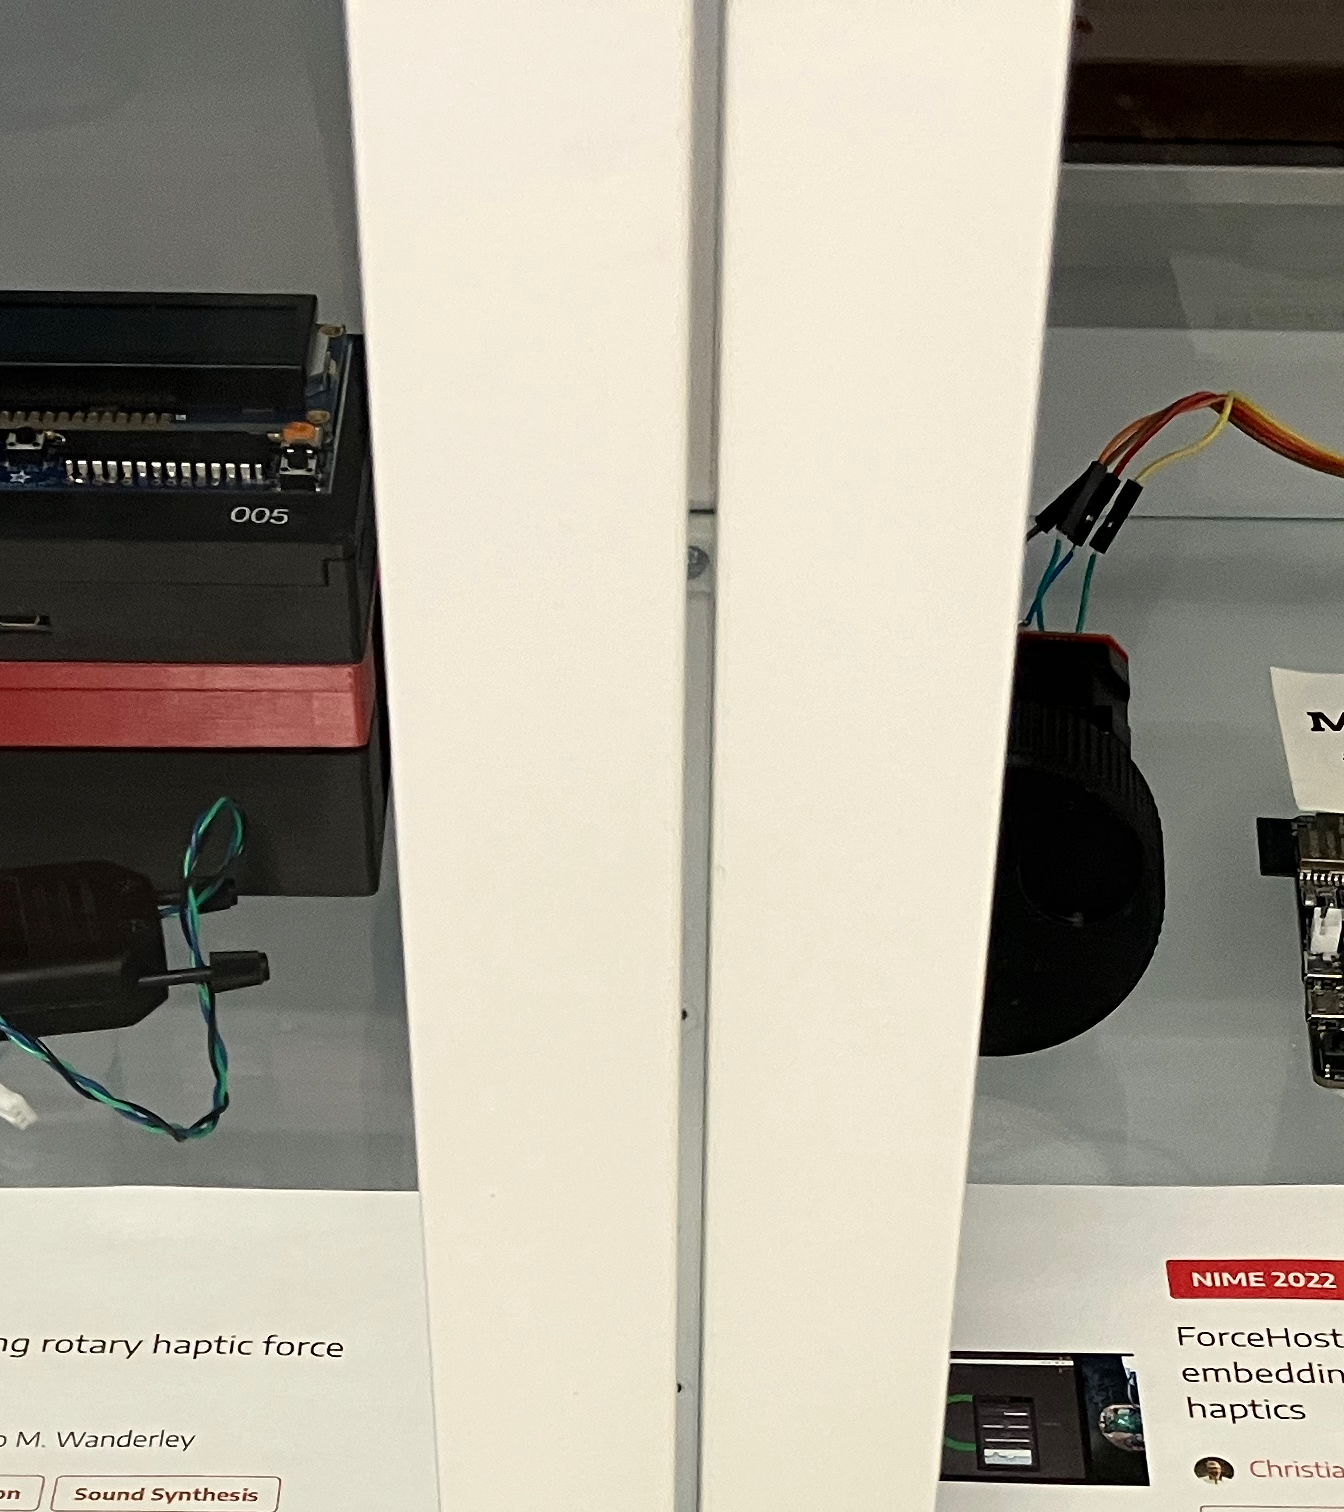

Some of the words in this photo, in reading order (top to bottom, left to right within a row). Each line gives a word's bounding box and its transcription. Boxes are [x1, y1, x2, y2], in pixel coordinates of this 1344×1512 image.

[230, 506, 289, 525] 005
[1192, 1271, 1266, 1288] NIME
[1271, 1271, 1336, 1289] 2022
[41, 1333, 143, 1359] rotary
[152, 1333, 253, 1360] haptic
[262, 1335, 344, 1359] force
[1187, 1397, 1306, 1424] haptics
[16, 1430, 46, 1449] M.
[57, 1430, 195, 1452] Wanderley
[74, 1487, 145, 1502] Sound
[150, 1487, 259, 1506] Synthesis
